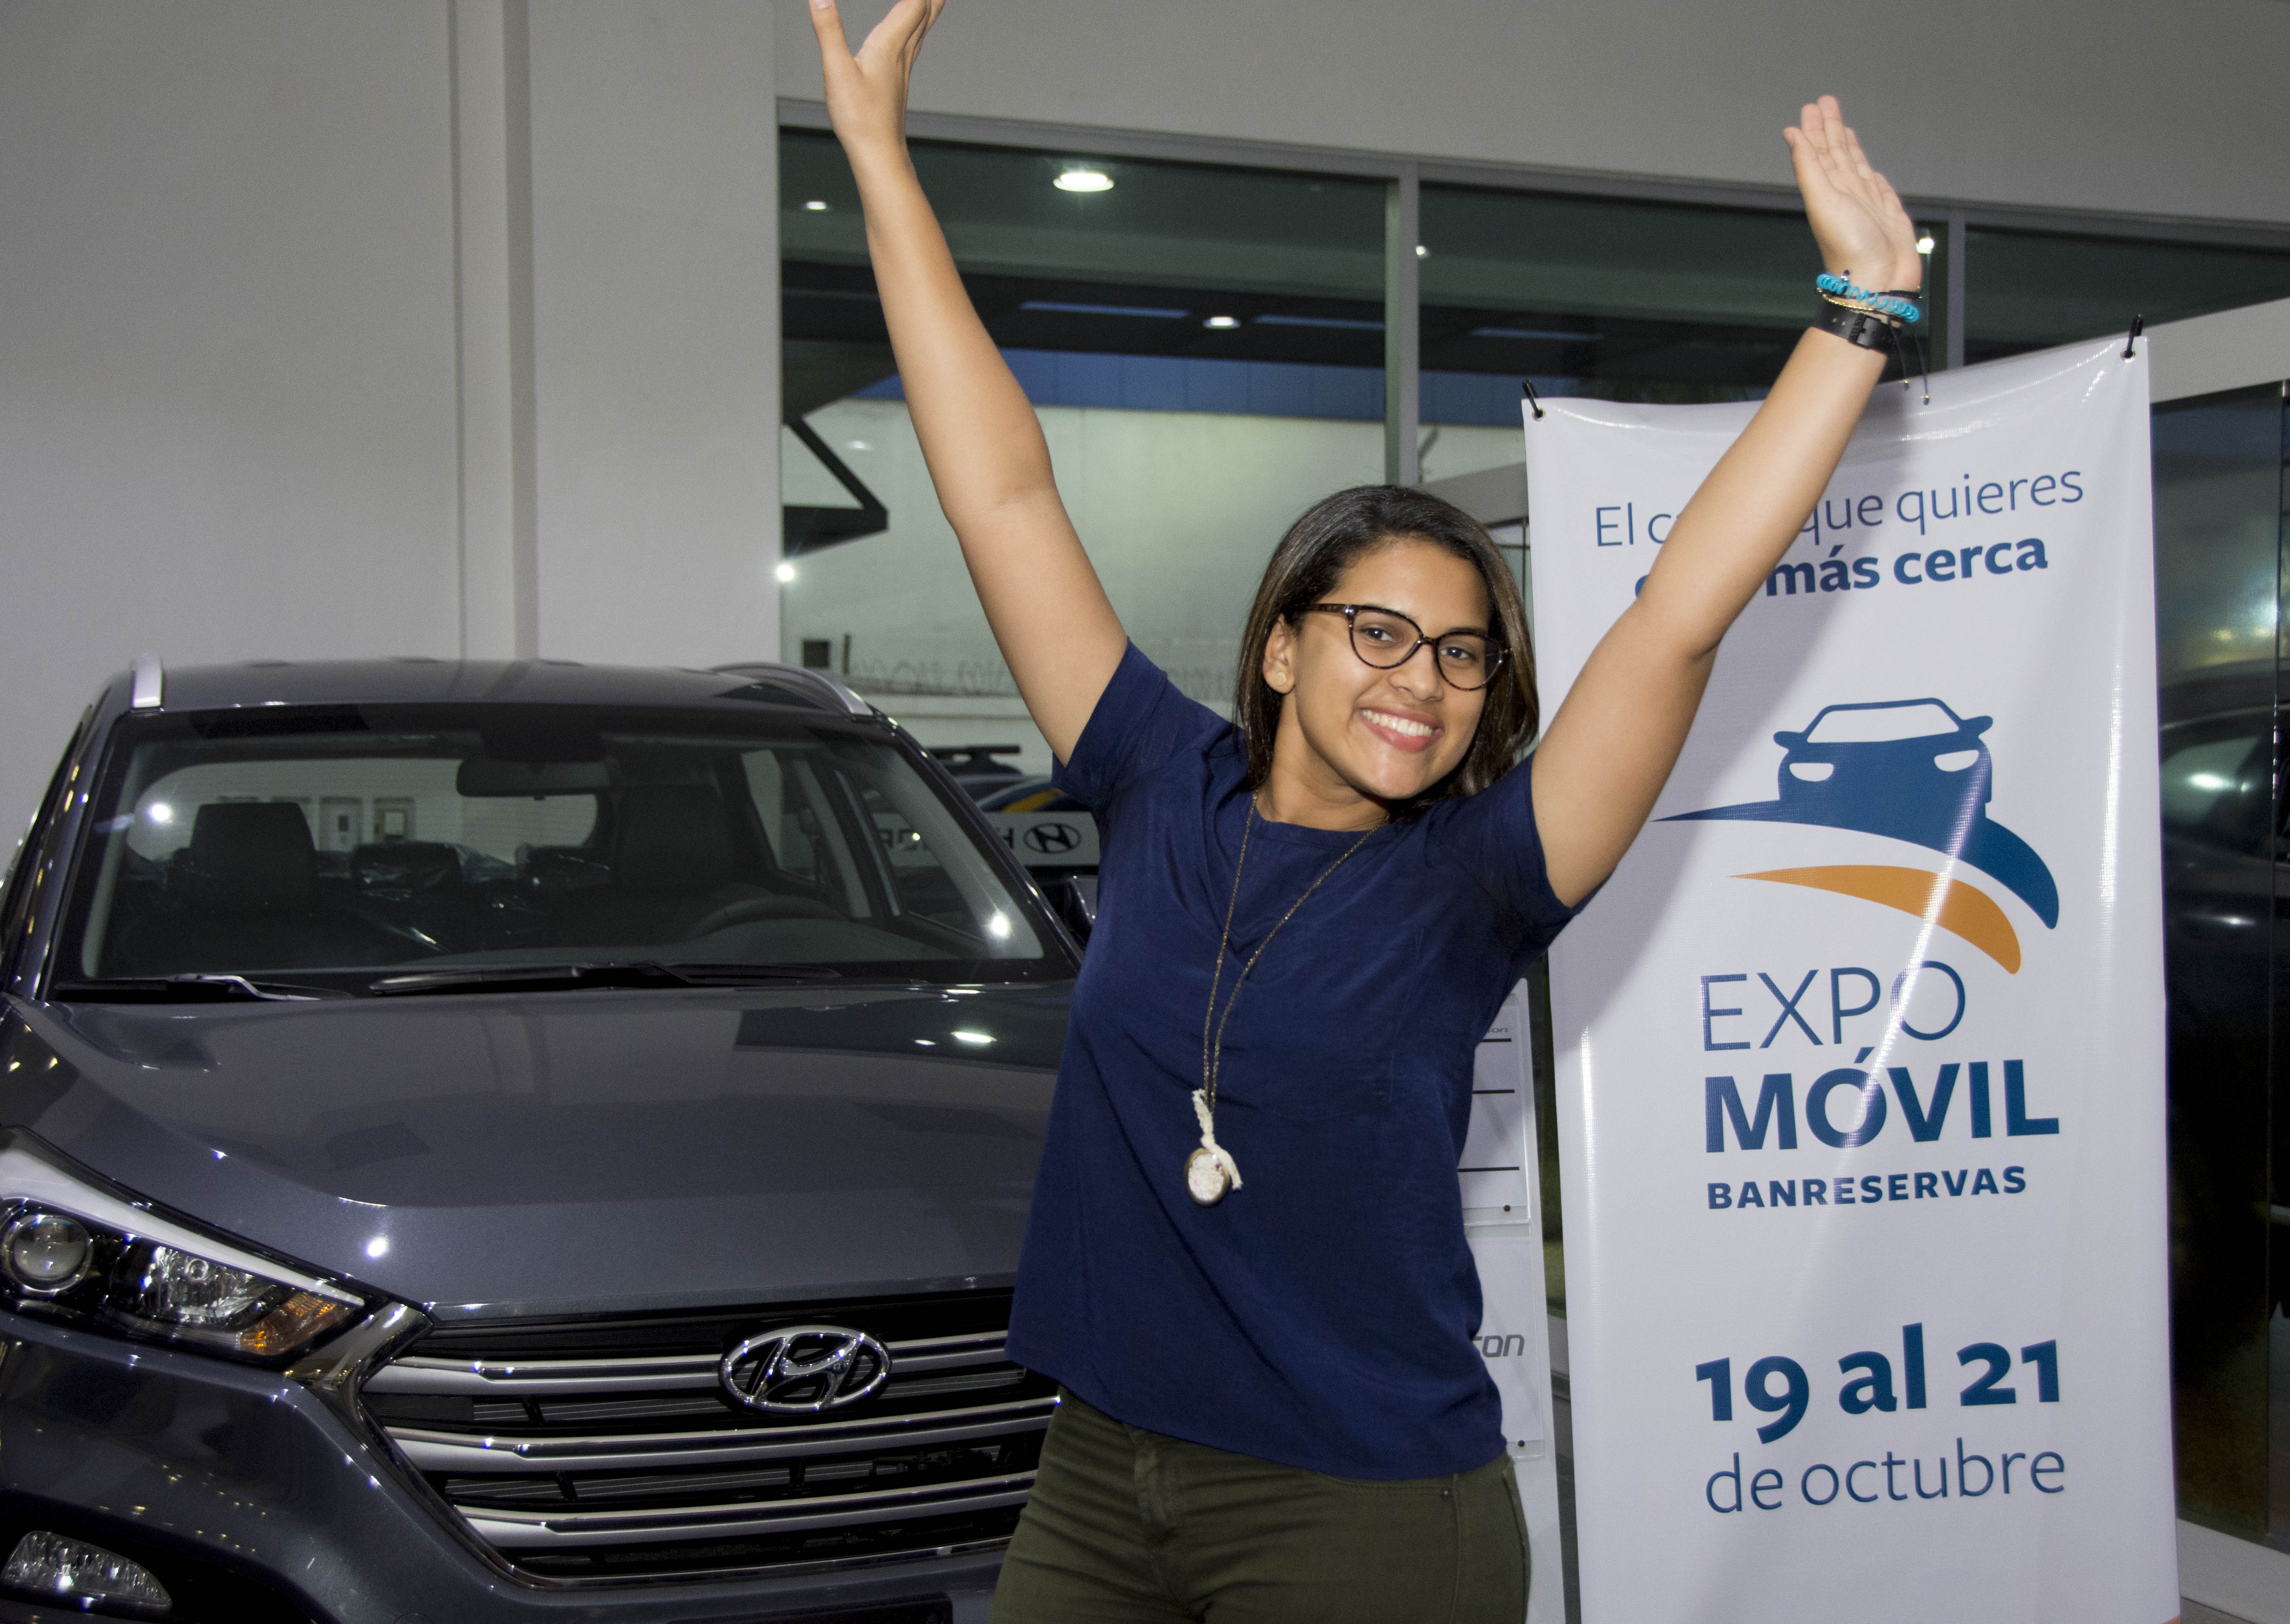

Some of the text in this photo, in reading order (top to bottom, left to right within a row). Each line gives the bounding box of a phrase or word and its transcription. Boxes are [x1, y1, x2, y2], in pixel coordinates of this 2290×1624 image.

[1596, 502, 1634, 546] El
[1896, 471, 2084, 535] quieres
[1766, 537, 2048, 597] más cerca
[1701, 960, 1965, 1051] EXPO
[1705, 1047, 2059, 1153] MÓVIL
[1707, 1166, 2026, 1209] BANRESERVAS
[1696, 1322, 2059, 1445] 19 al 21
[1706, 1437, 2065, 1513] de octubre
